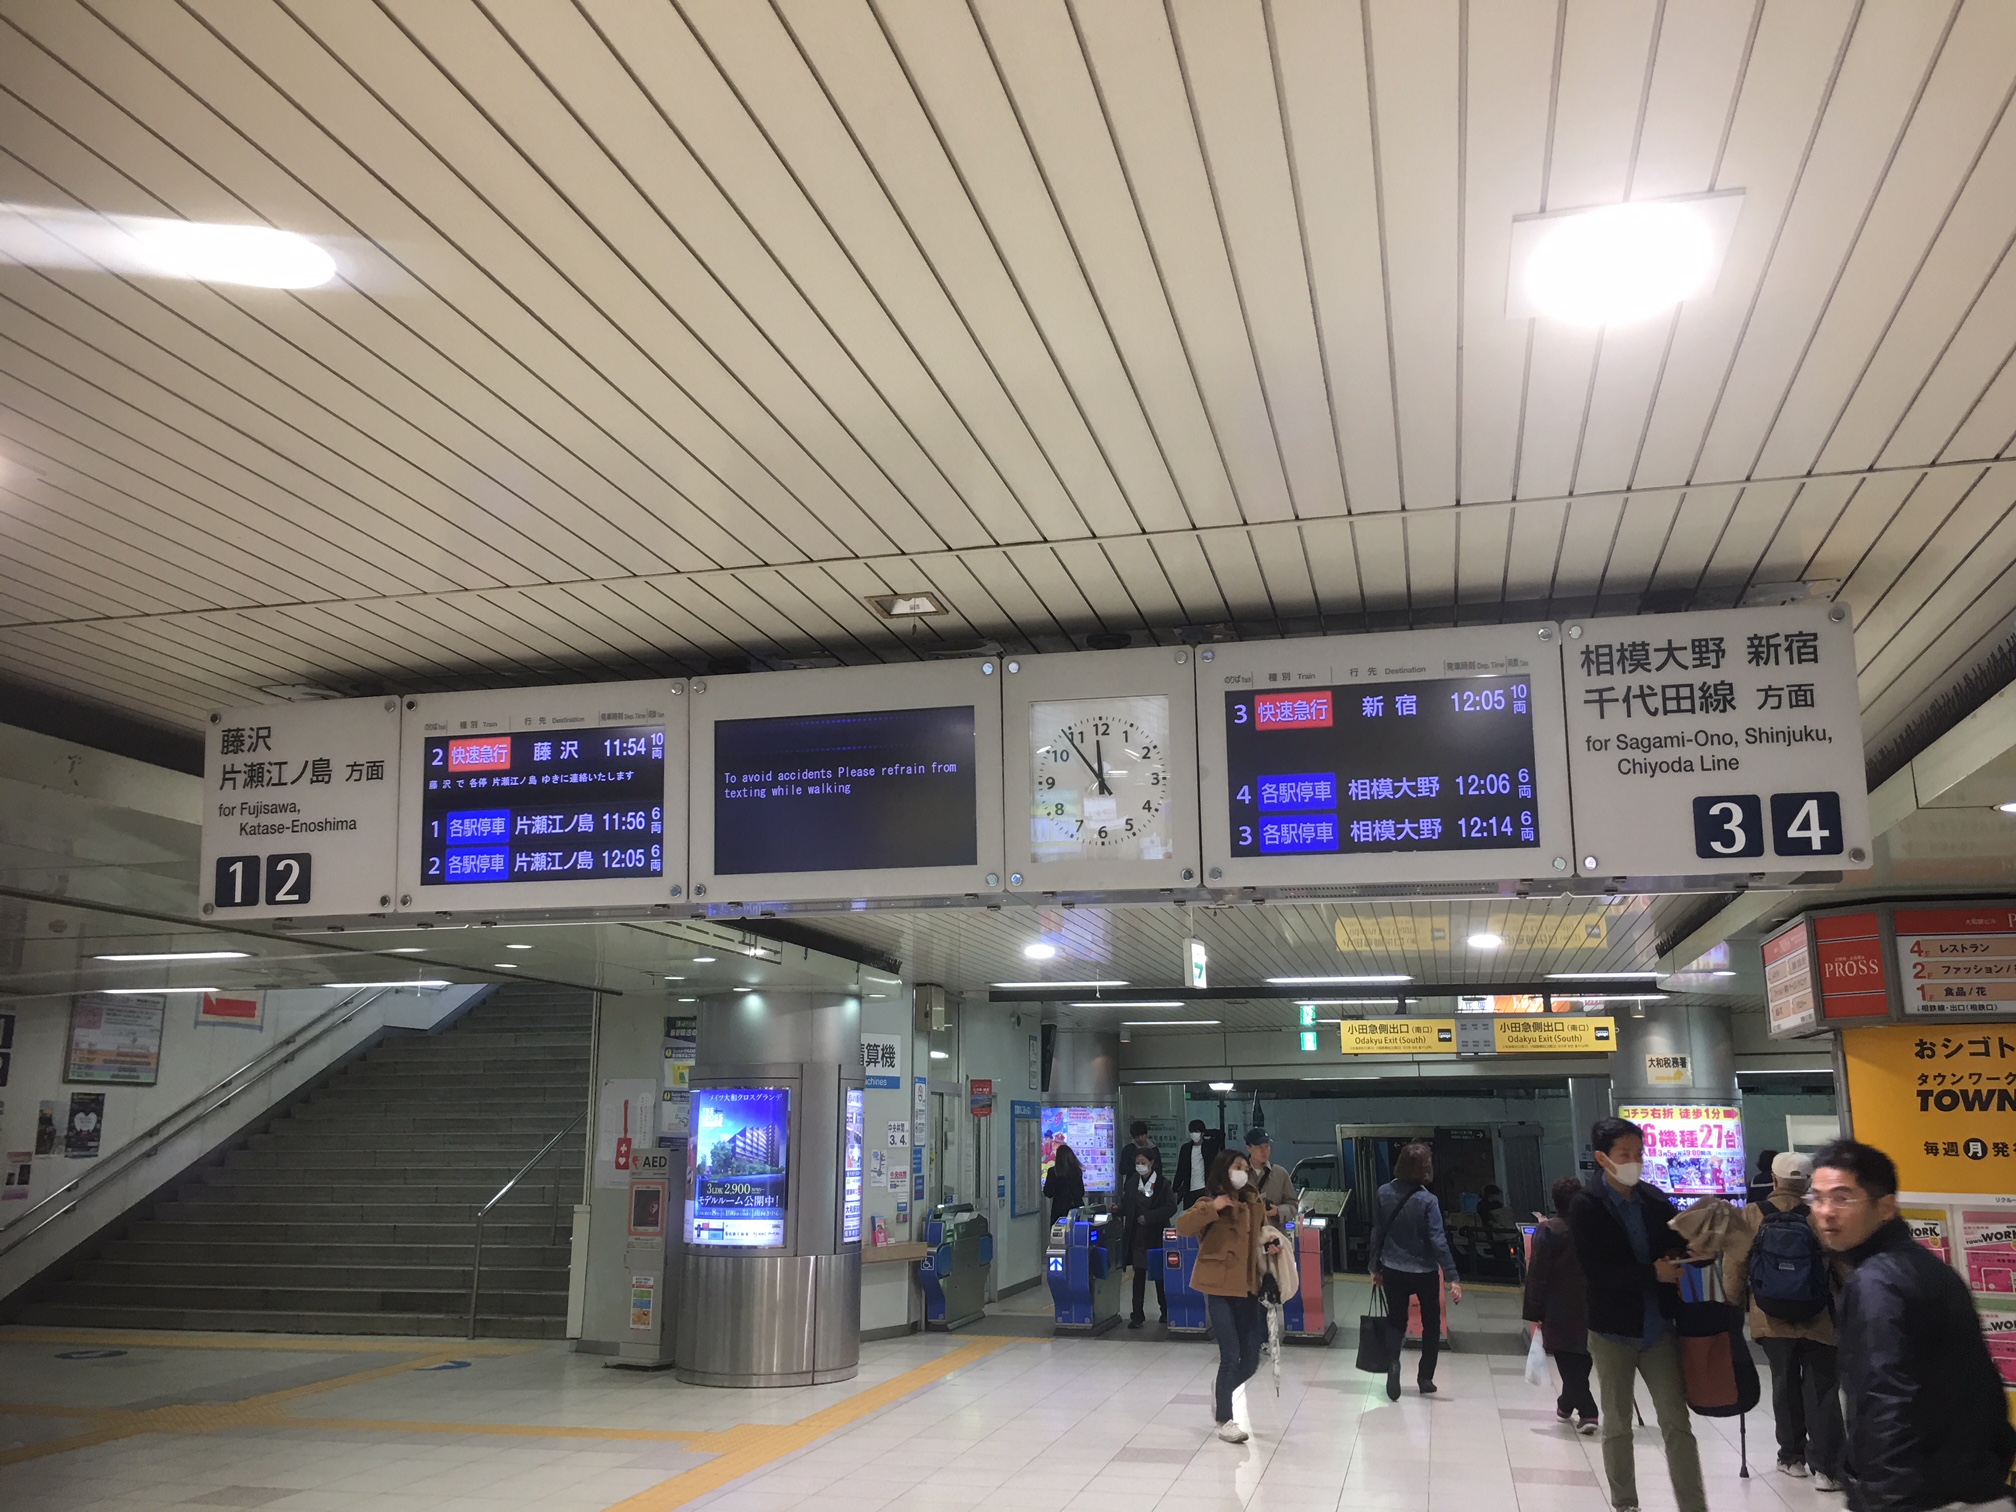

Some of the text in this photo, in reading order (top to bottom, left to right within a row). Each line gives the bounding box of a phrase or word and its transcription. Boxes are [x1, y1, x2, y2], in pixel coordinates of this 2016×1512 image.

[1580, 631, 1818, 676] 相模大野 新宿
[1268, 672, 1316, 682] 種別 Train
[1349, 666, 1427, 678] 行先 Destination
[1511, 684, 1527, 699] 10
[1234, 690, 1505, 723] 3 快速急行 新宿 12:05
[1583, 680, 1814, 719] 千代田線 方面
[1513, 701, 1526, 714] 両
[552, 716, 585, 725] Destination
[1093, 722, 1110, 736] 12
[1123, 729, 1131, 743] 1
[221, 726, 272, 755] 藤沢
[651, 733, 664, 747] 10
[1068, 731, 1084, 744] 11
[1585, 725, 1832, 753] for Sagami-Ono, Shinjuku,
[431, 738, 647, 766] 2 快速急行 藤沢 11:54
[652, 748, 663, 760] 両
[1052, 749, 1070, 763] 10
[1142, 746, 1152, 760] 2
[724, 761, 957, 784] To avoid accidents Please refrain from
[1617, 755, 1739, 778] Chiyoda Line
[219, 757, 385, 791] 片瀬江ノ島 方面
[493, 775, 538, 787] 片瀬江ノ島
[542, 771, 635, 785] ゆきに連絡いたします
[1151, 772, 1161, 786] 3
[1518, 769, 1529, 783] 6
[724, 782, 852, 799] texting while walking
[1046, 777, 1056, 790] 9
[1236, 774, 1510, 804] 4 各駅停車 相模大野 12:06
[1518, 785, 1532, 799] 両
[218, 802, 301, 819] for Fujisawa,
[651, 807, 661, 820] 6
[1054, 803, 1064, 816] 8
[1142, 800, 1153, 813] 4
[432, 811, 646, 838] 1 各駅停車 片瀬江ノ島 11:56
[1124, 818, 1134, 832] 5
[1521, 811, 1532, 825] 6
[1787, 799, 1829, 851] 4
[240, 818, 357, 836] Katase-Enoshima
[651, 821, 663, 834] 両
[1075, 819, 1084, 833] 7
[1098, 825, 1108, 839] 6
[1239, 816, 1513, 845] 3 各駅停車 相模大野 12:14
[1708, 802, 1746, 854] 3
[1521, 828, 1534, 841] 両
[651, 844, 661, 857] 6
[429, 849, 646, 875] 2 各駅停車 片瀬江ノ島 12:05
[650, 858, 662, 871] 両
[229, 861, 244, 903] 1
[275, 859, 301, 902] 2
[1939, 944, 1989, 953] レストラン
[1825, 959, 1879, 978] PROSS
[1941, 964, 2016, 975] ファッション/
[1355, 1036, 1426, 1045] Odakyu Exit (South)
[1507, 1034, 1582, 1043] Odakyu Exit (South)
[1914, 1036, 2016, 1059] おシゴト
[1649, 1057, 1687, 1069] 大和税務署
[1917, 1072, 2016, 1086] タウンワーク
[1916, 1089, 2016, 1112] TOWN
[1623, 1109, 1720, 1120] コチラ右折 徒歩1分
[1637, 1123, 1737, 1149] 6機種27台
[1924, 1141, 2016, 1157] 毎週月発
[643, 1156, 668, 1168] AED
[725, 1183, 751, 1195] 2,900
[699, 1195, 779, 1207] モデルルーム公開中!
[1991, 1319, 2016, 1331] WO
